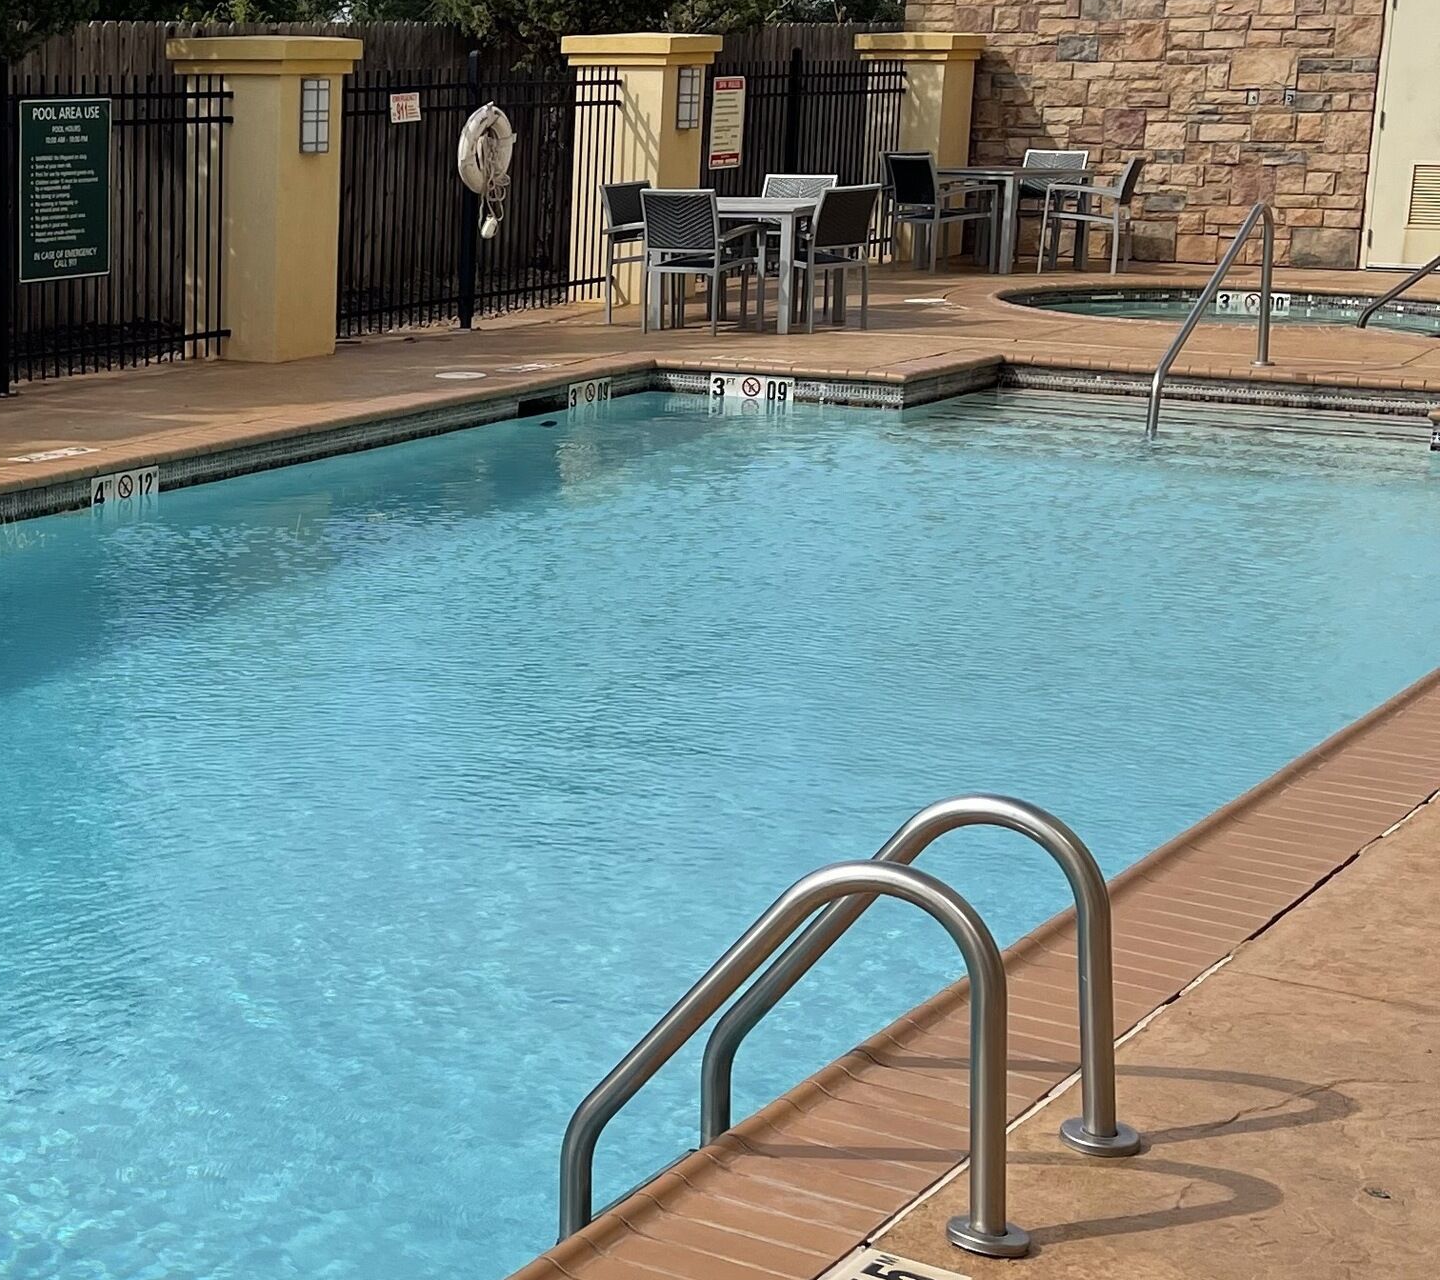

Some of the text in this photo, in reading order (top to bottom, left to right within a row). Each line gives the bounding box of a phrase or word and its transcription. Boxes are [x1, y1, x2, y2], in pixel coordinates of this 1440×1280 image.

[32, 106, 100, 120] POOL AREA USE
[33, 247, 97, 261] IN CASE OF EMERGENCY
[53, 259, 67, 268] CALL
[712, 377, 726, 396] 3
[93, 481, 105, 504] 4
